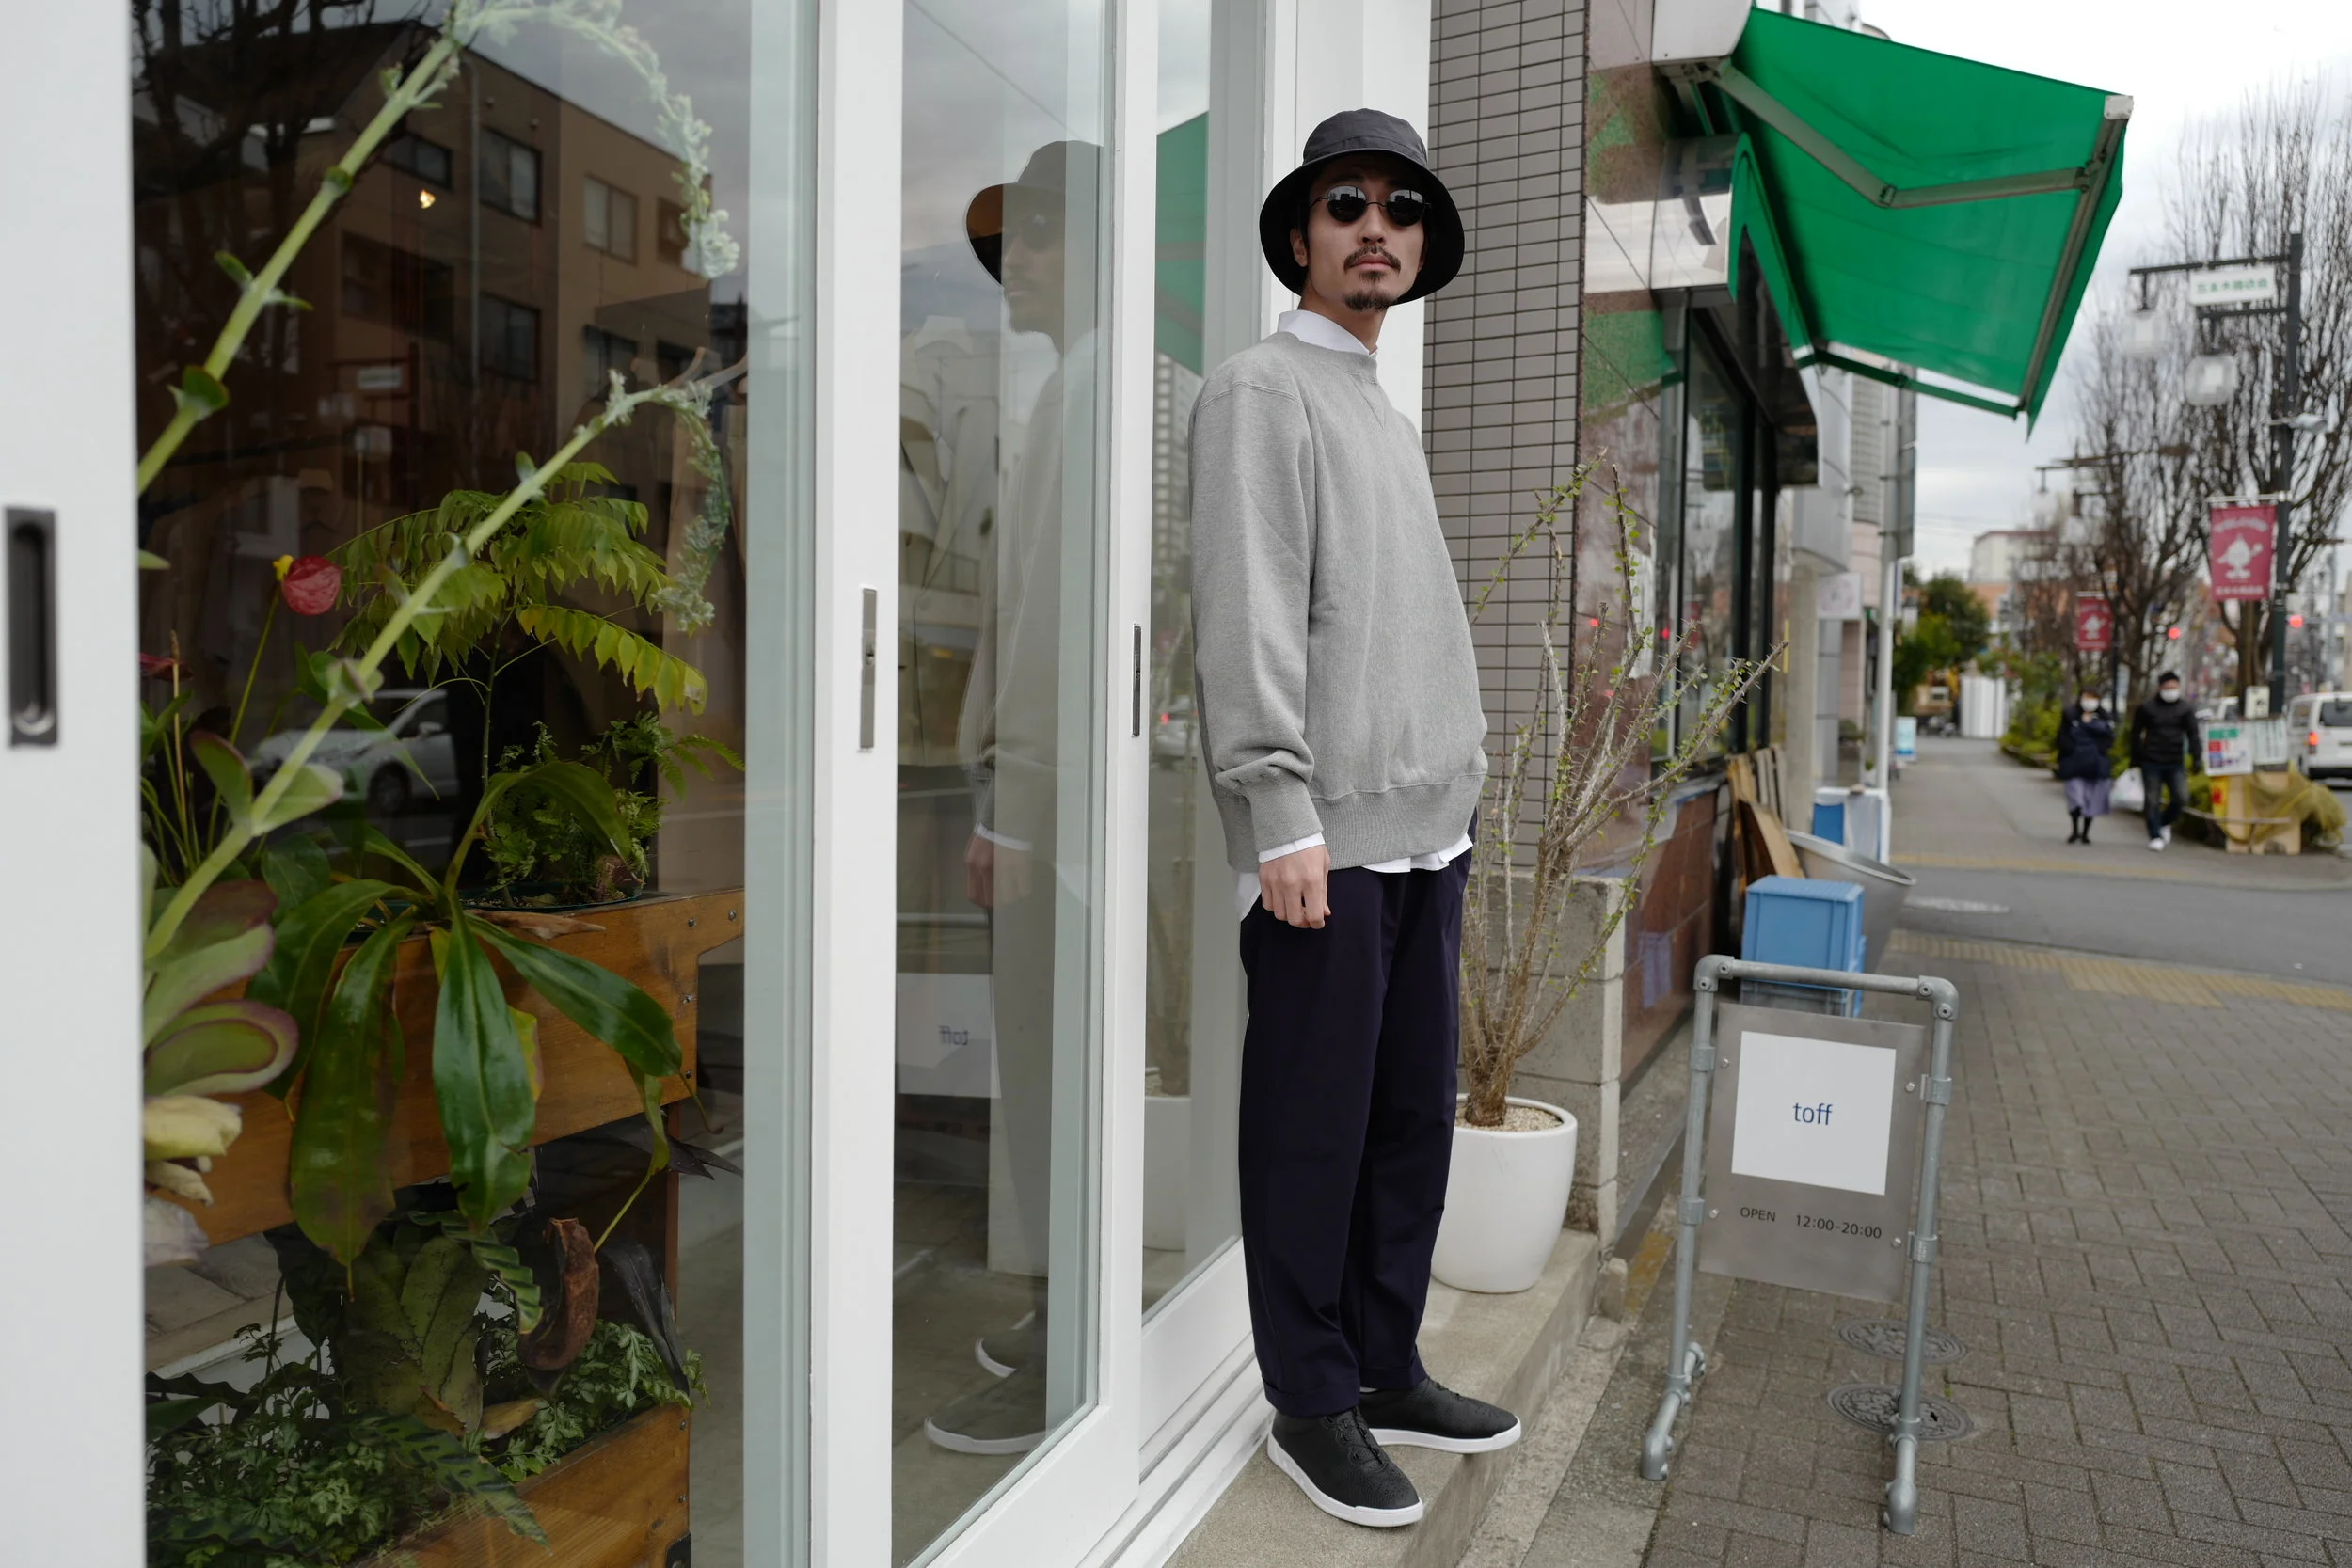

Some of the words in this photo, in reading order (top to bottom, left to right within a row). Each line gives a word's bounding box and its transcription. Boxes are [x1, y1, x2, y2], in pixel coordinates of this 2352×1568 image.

[1792, 1102, 1834, 1125] toff
[1740, 1207, 1776, 1222] OPEN
[1796, 1214, 1882, 1239] 12:00-20:00
